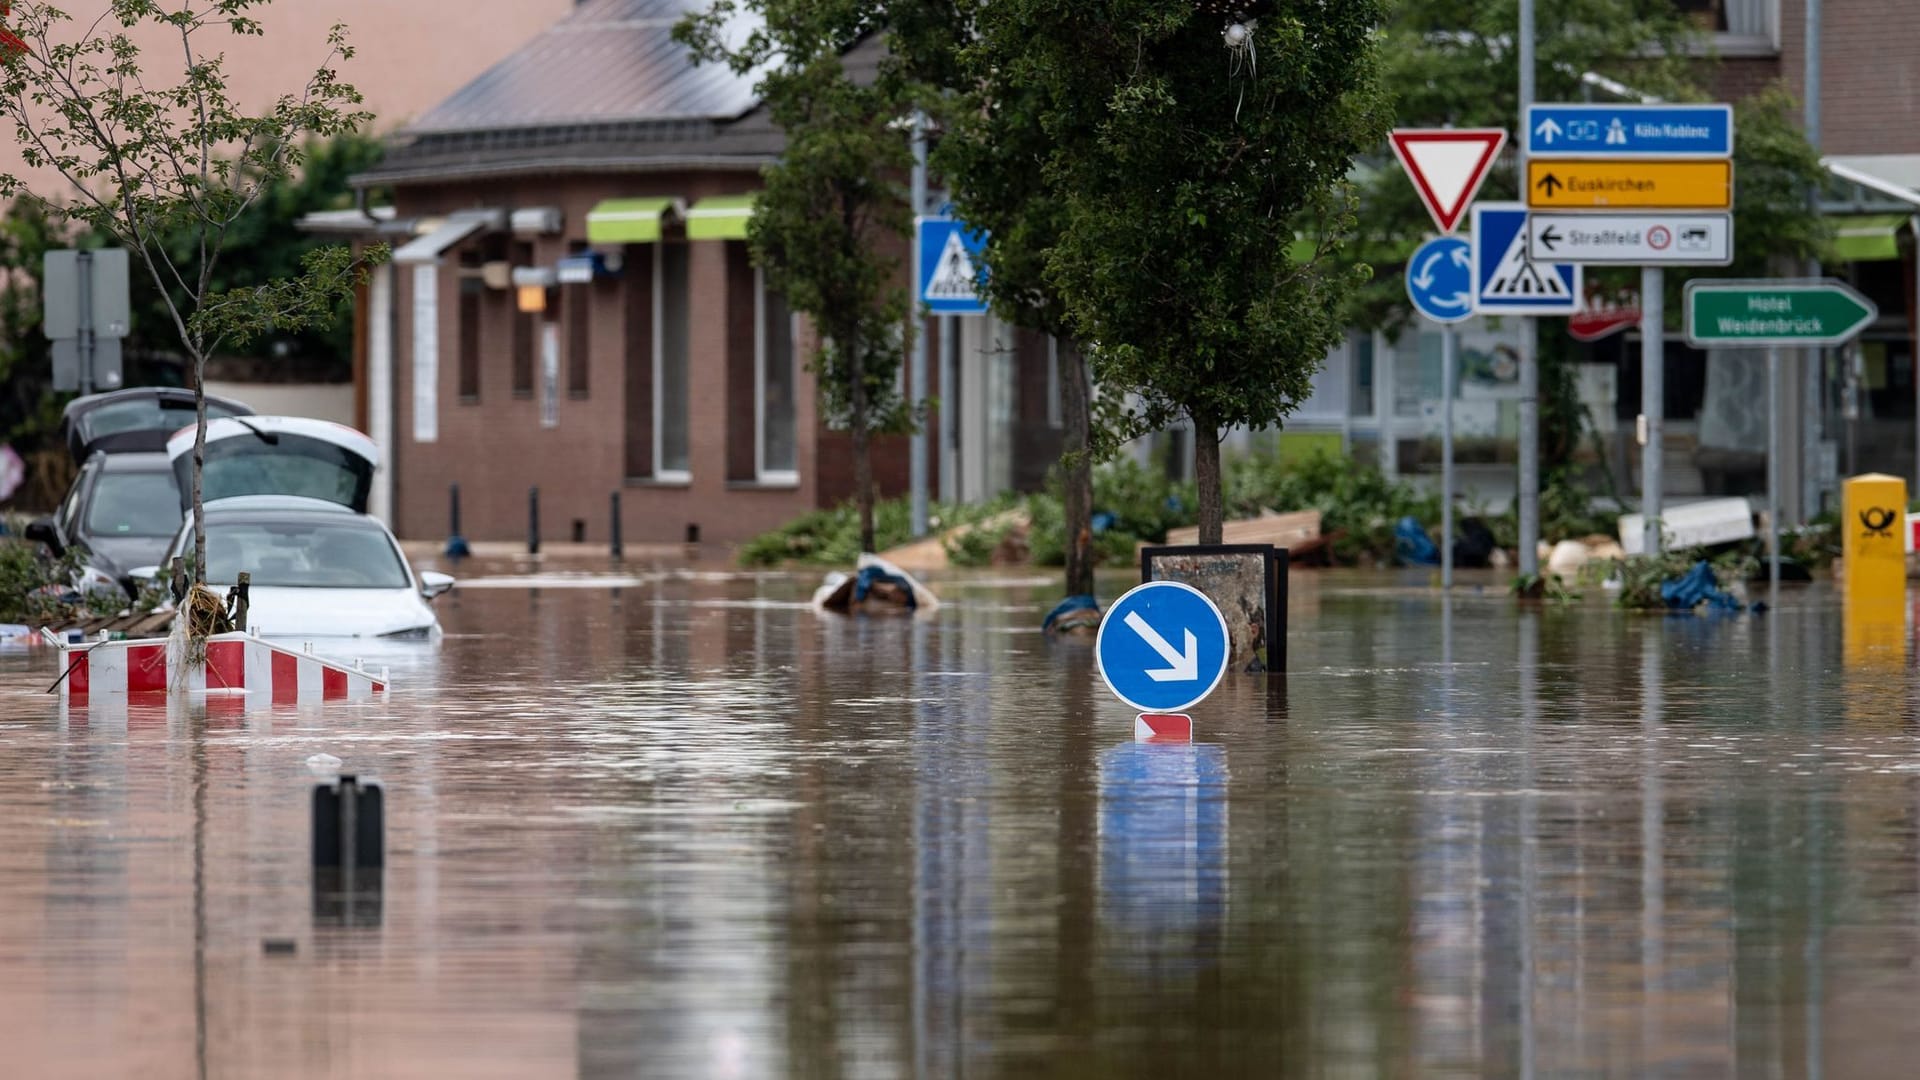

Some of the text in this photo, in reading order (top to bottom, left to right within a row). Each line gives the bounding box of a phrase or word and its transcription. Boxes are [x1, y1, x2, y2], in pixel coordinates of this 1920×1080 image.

[1568, 176, 1655, 192] Euskirchen
[1569, 229, 1641, 245] Straßfeld
[1748, 295, 1791, 312] Hotel
[1717, 315, 1823, 334] Weidenbrück
